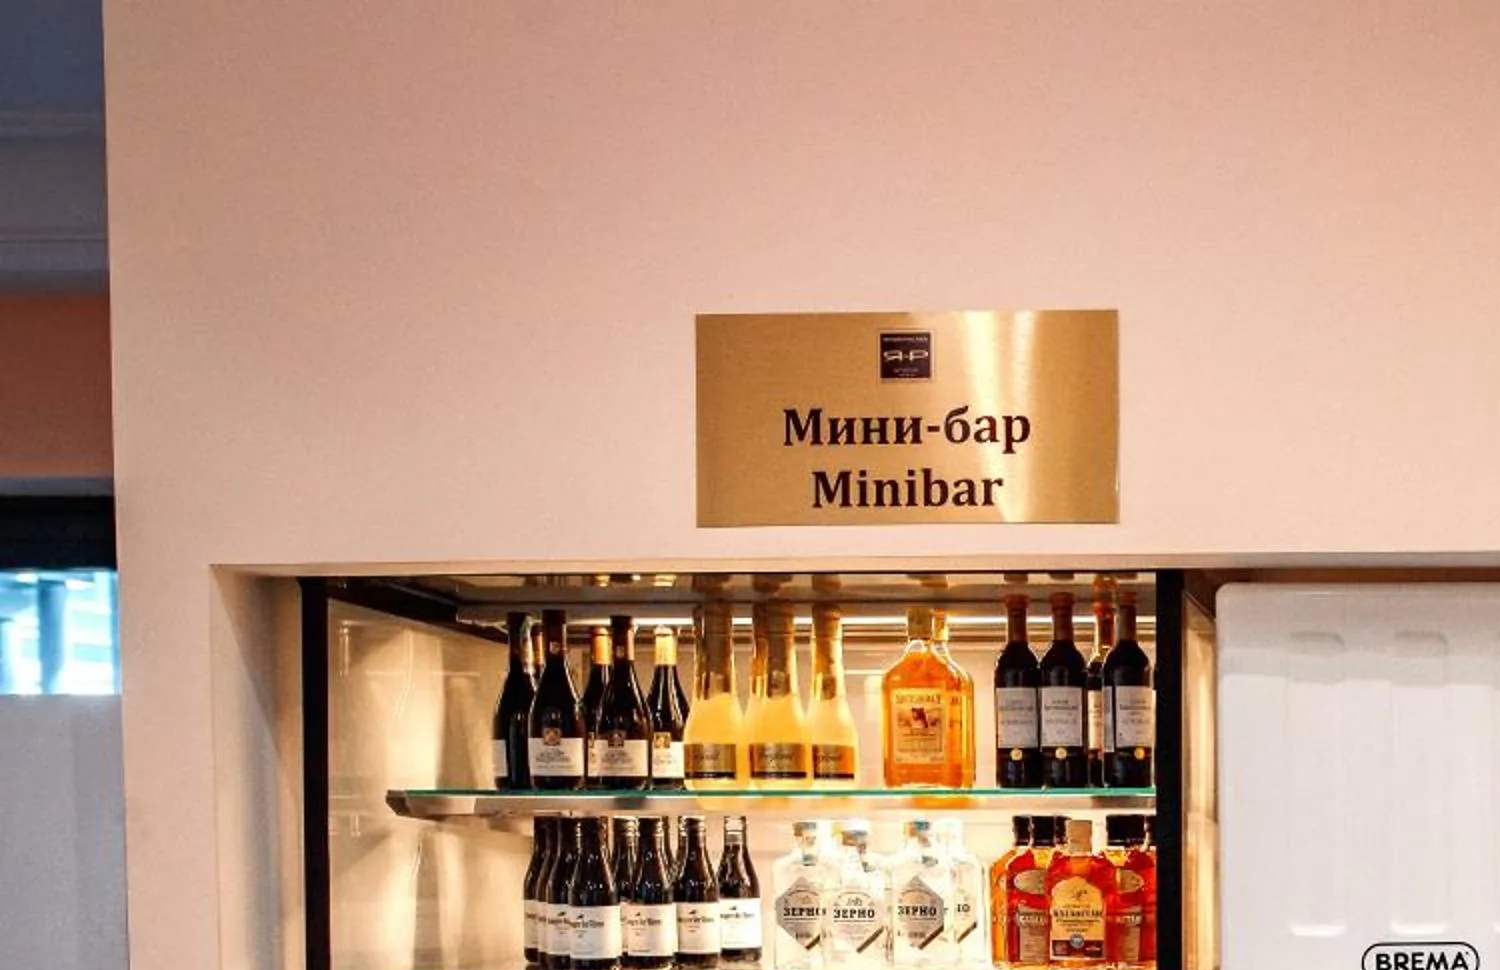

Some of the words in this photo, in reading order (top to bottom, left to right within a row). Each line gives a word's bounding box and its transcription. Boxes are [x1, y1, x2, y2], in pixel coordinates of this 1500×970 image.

[783, 405, 1031, 454] Мини-бар
[812, 468, 1004, 507] Minibar
[833, 908, 876, 919] ЗЕРНО
